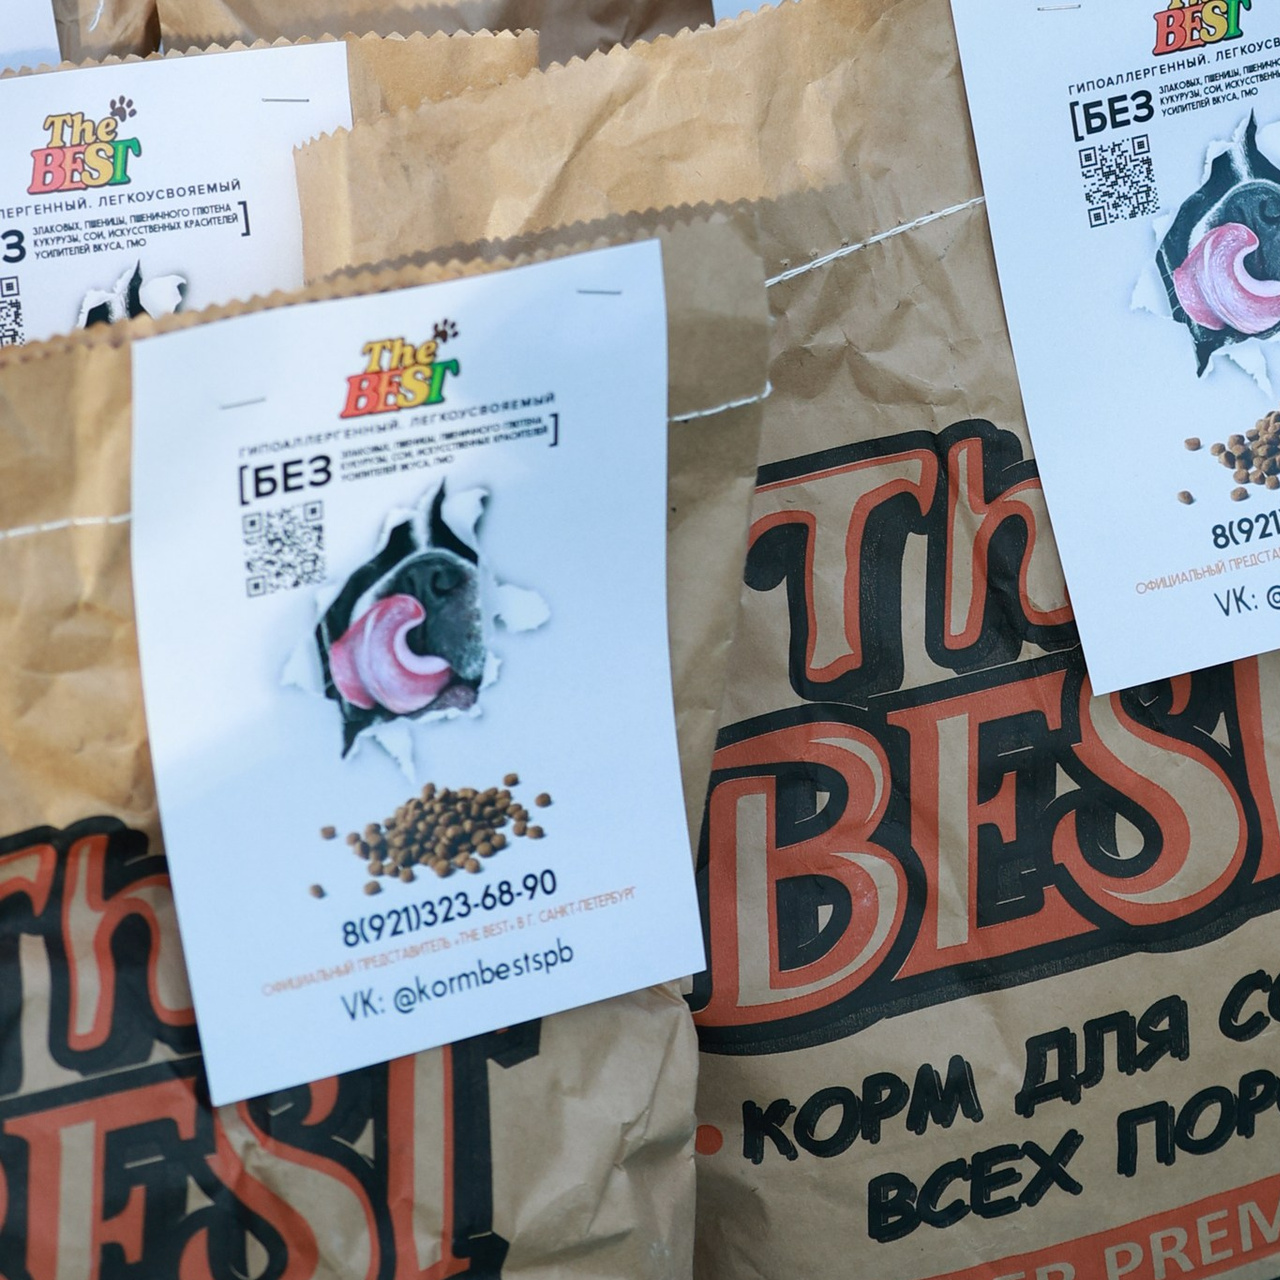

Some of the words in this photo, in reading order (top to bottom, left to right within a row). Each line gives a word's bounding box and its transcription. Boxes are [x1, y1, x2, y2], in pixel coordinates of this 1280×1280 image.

[1241, 88, 1258, 98] ГМО
[43, 112, 117, 148] The
[26, 137, 142, 195] BEST
[99, 179, 240, 207] ЛЕГКОУСВОЯЕМЫЙ
[184, 214, 238, 228] КРАСИТЕЛЕЙ
[127, 239, 146, 247] ГМО
[362, 337, 438, 374] The
[340, 359, 460, 419] BEST
[745, 419, 1090, 700] Th
[1136, 561, 1226, 594] ОФИЦИАЛЬНЫЙ
[1214, 586, 1258, 616] VK:
[343, 869, 556, 947] 8(921)323-68-90
[341, 988, 384, 1020] VK:
[394, 938, 573, 1014] @kormbestspb
[742, 1055, 982, 1164] КОРМ
[1016, 994, 1190, 1116] ДЛЯ
[866, 1129, 1083, 1244] ВСЕХ
